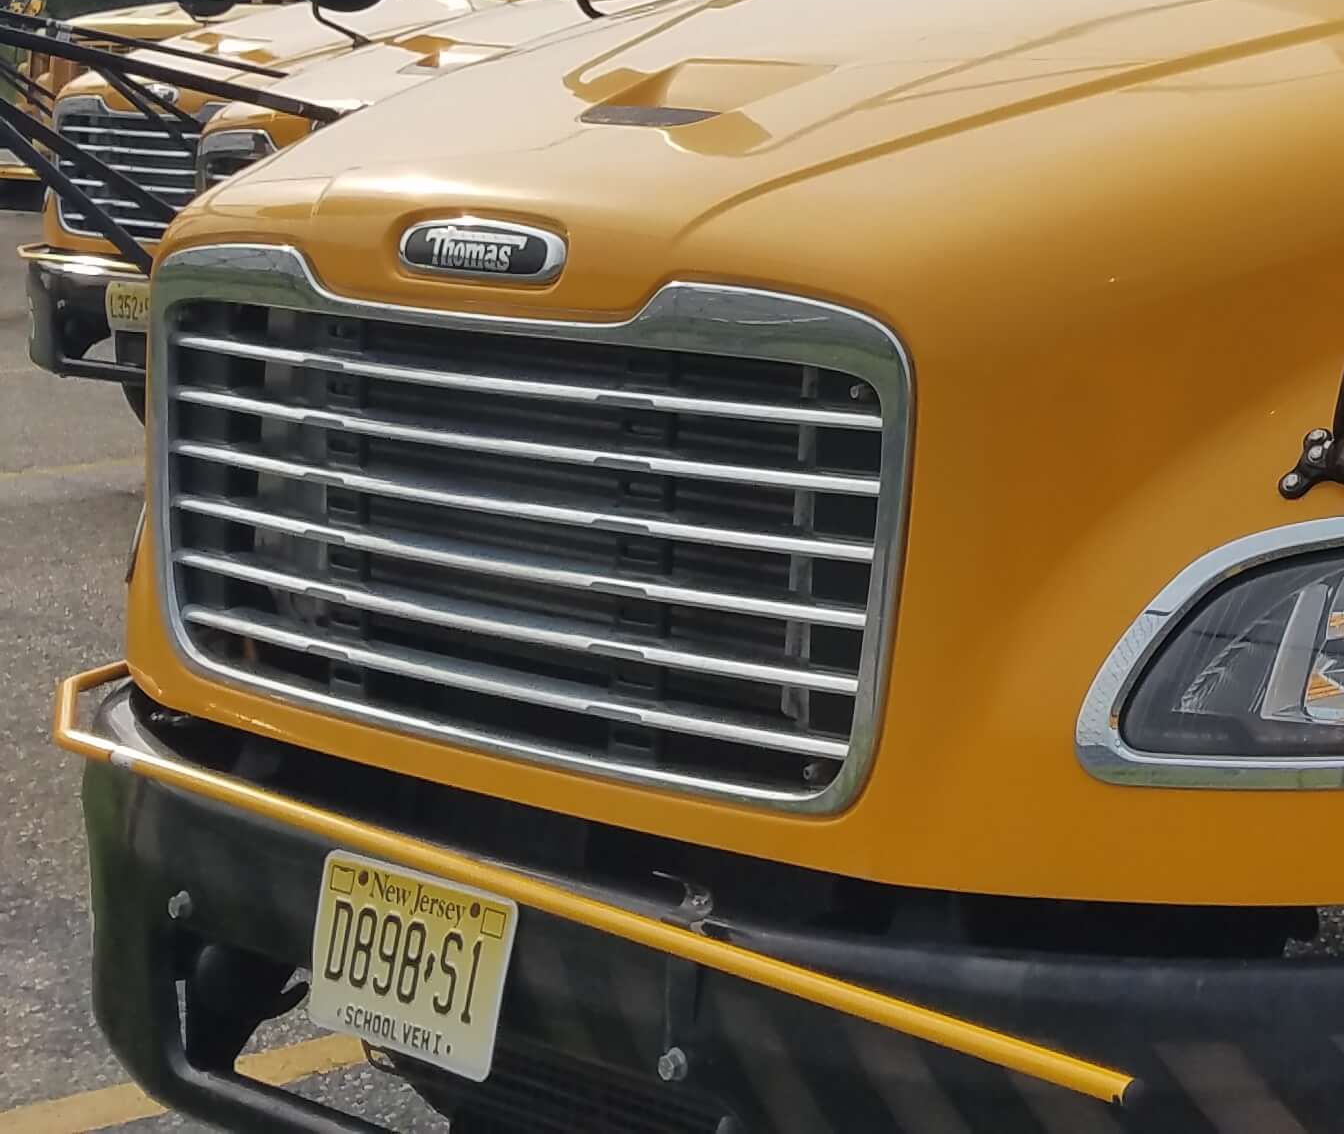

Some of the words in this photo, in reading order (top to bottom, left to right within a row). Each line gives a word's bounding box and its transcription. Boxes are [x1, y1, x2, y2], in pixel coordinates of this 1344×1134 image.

[426, 226, 528, 272] Thomas
[370, 870, 410, 907] New
[409, 883, 467, 927] Jersey
[344, 1005, 397, 1042] SCHOOL
